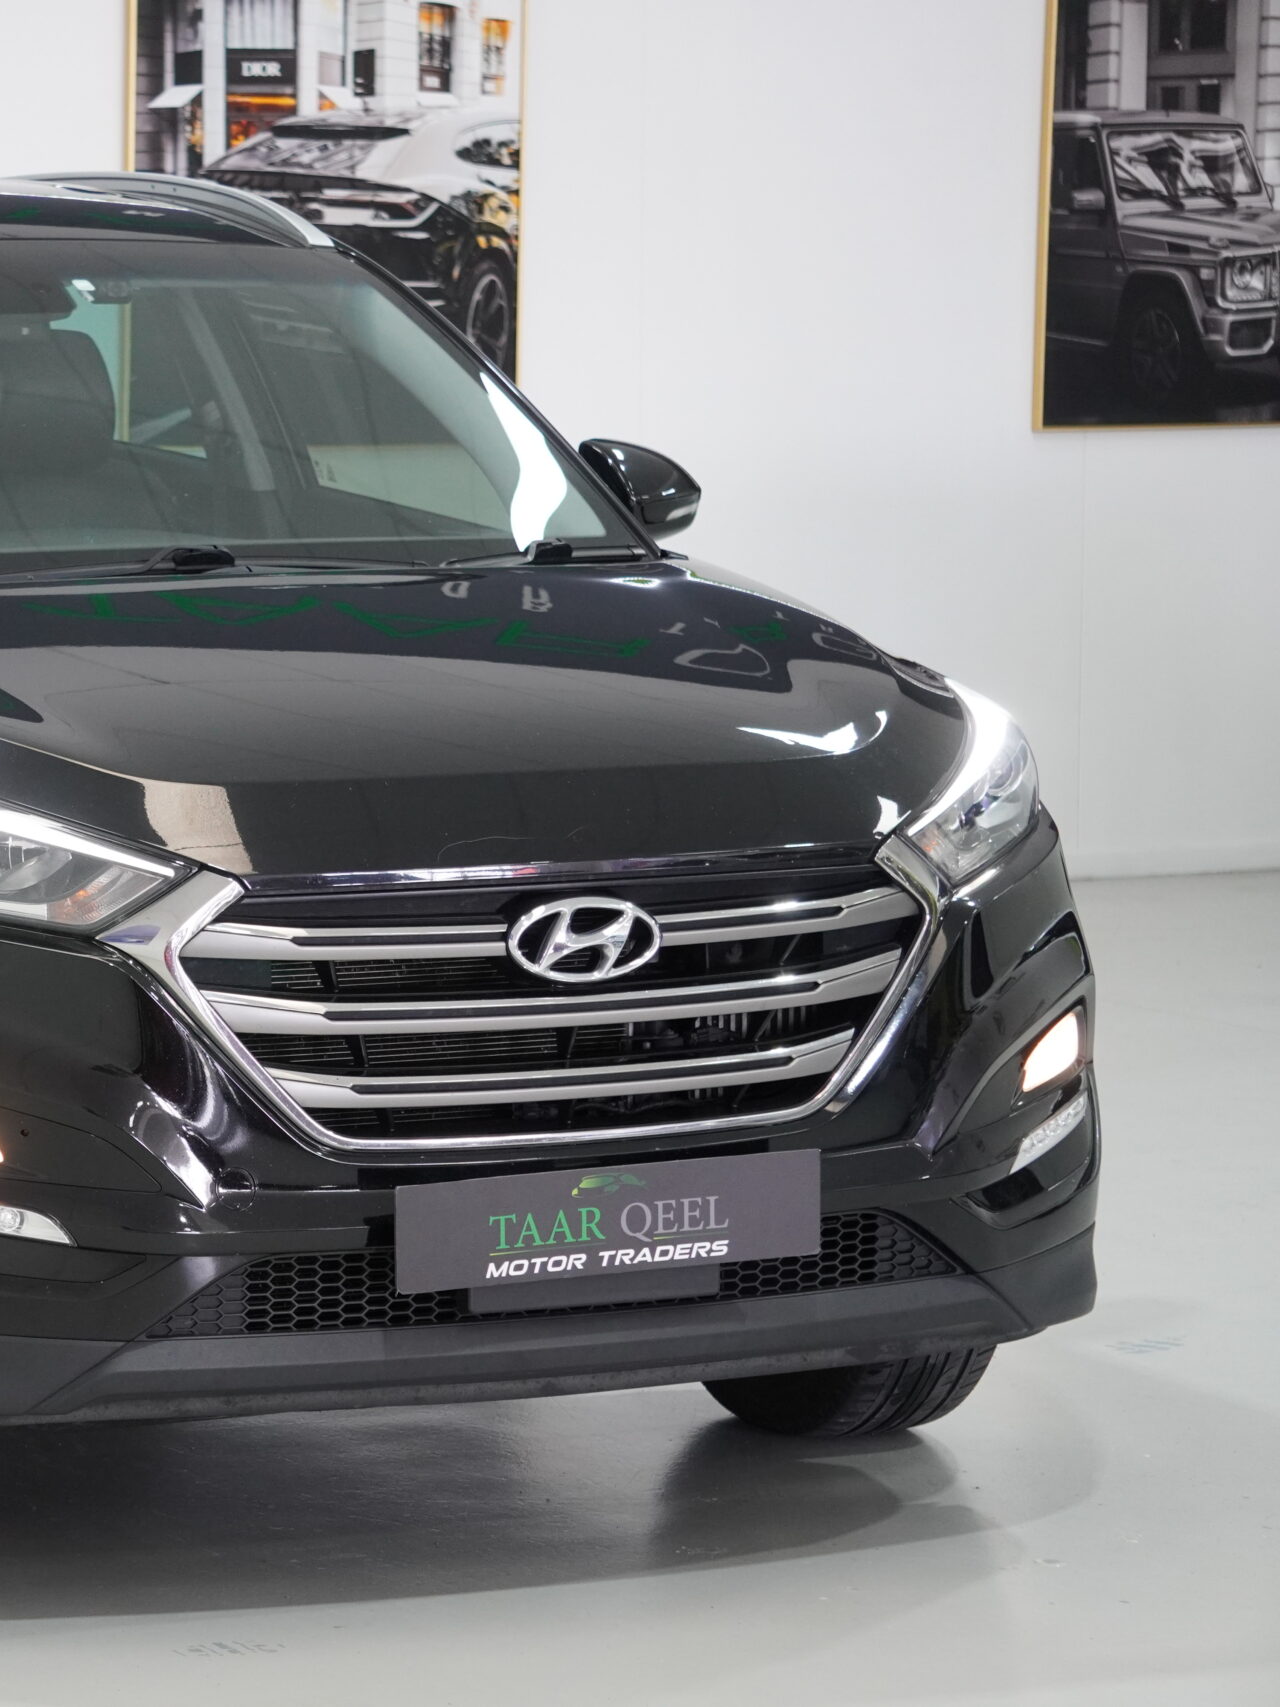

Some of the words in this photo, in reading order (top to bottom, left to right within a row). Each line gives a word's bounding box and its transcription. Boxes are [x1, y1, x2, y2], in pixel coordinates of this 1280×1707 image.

[240, 61, 282, 77] DIOR
[489, 1207, 606, 1250] TAAR
[621, 1195, 729, 1242] QEEL
[485, 1253, 587, 1279] MOTOR
[598, 1240, 730, 1267] TRADERS
